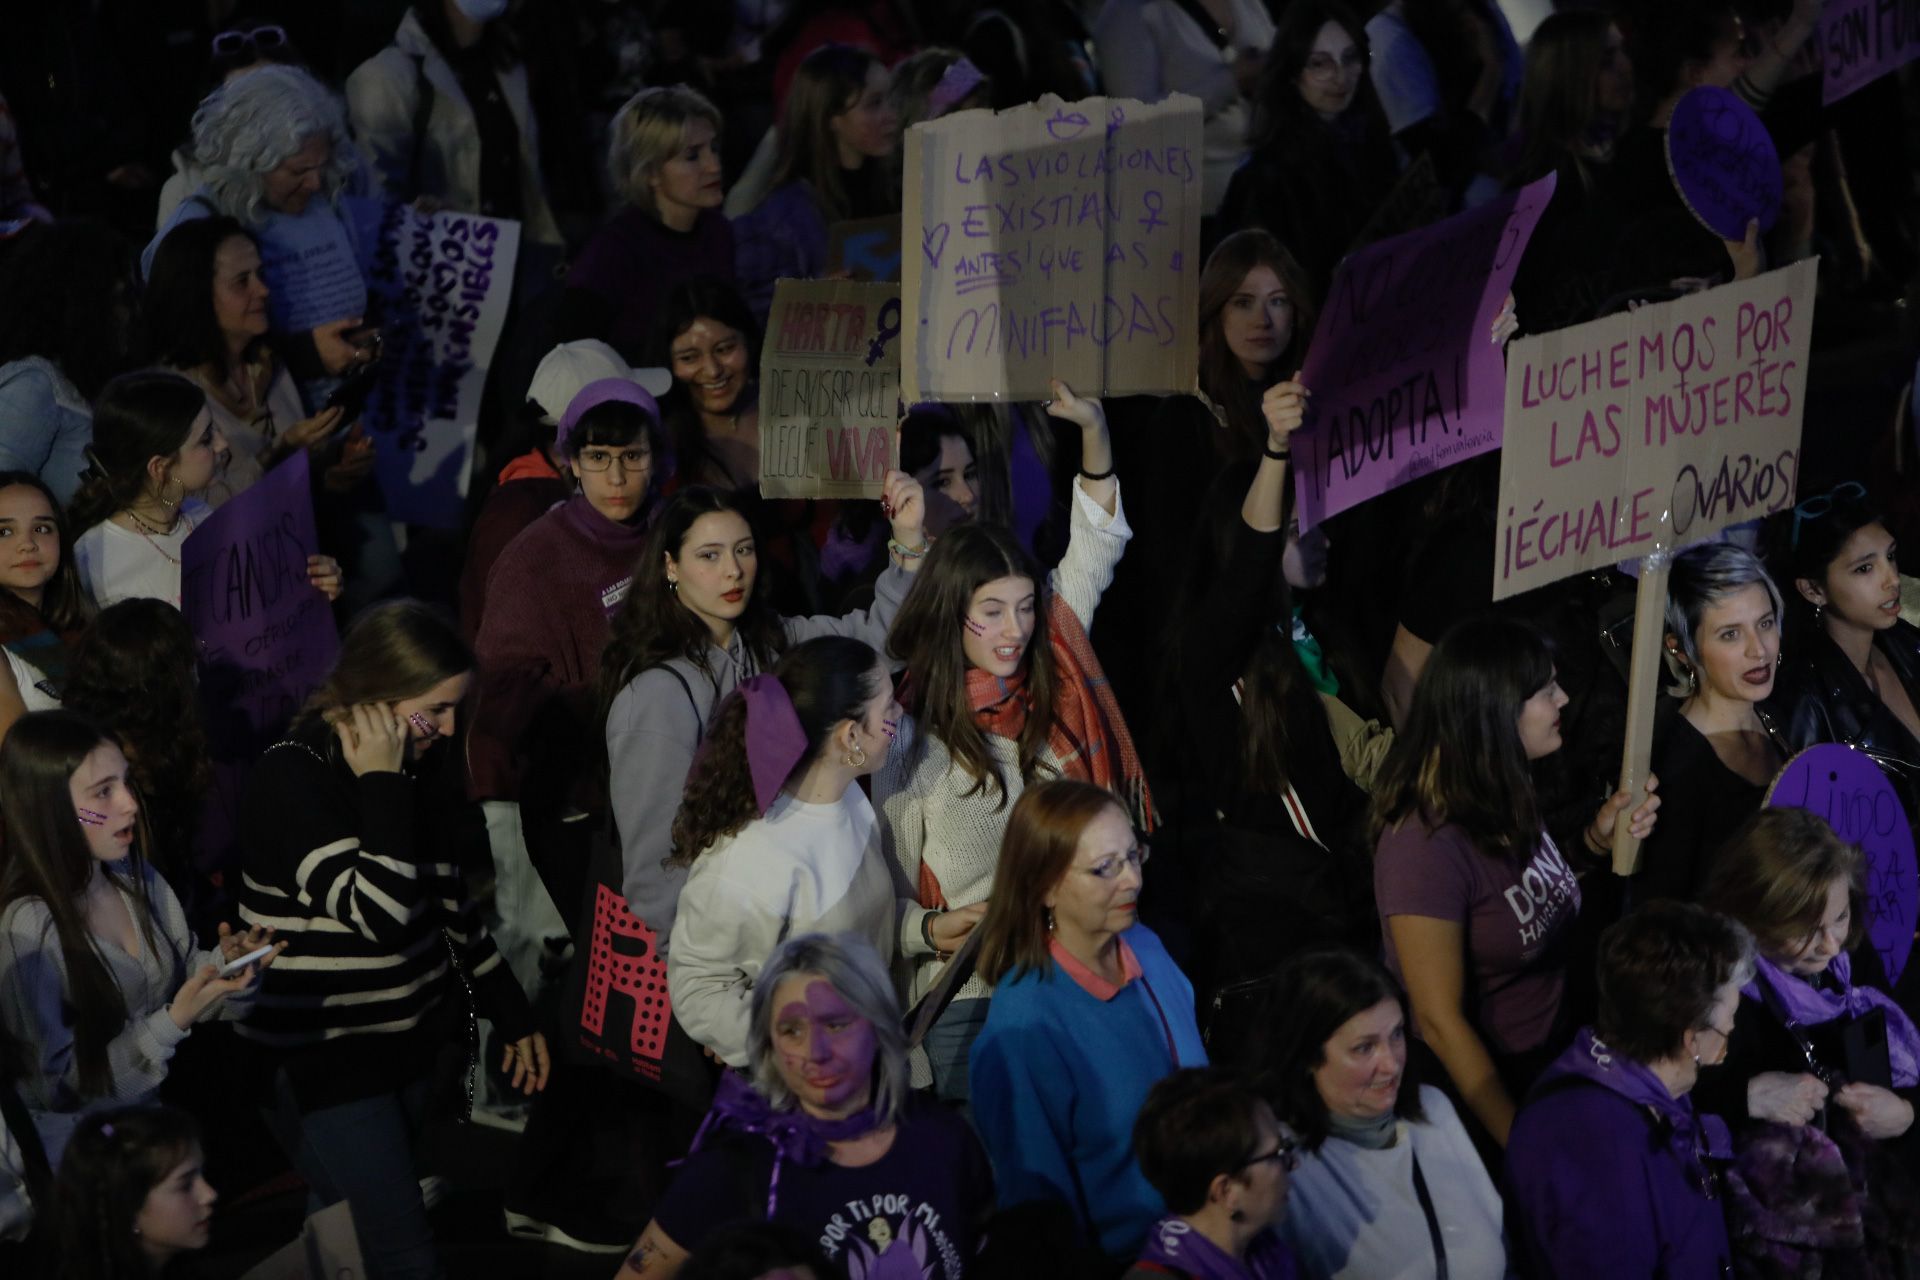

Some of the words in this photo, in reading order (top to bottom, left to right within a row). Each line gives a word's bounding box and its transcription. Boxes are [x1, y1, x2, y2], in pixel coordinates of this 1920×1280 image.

[1828, 5, 1869, 78] SON
[956, 153, 1020, 186] LAS
[1027, 146, 1194, 182] VIOLACIONES
[1039, 244, 1083, 280] QUE
[777, 302, 866, 352] HARTA
[947, 292, 1175, 360] MINIFALDAS
[1521, 316, 1716, 409] LUCHEMOS
[1736, 296, 1793, 370] POR
[770, 369, 793, 417] DE
[794, 369, 854, 418] AVISAR
[858, 370, 891, 418] QUE
[1549, 404, 1622, 468] LAS
[1645, 361, 1796, 446] MUJERES
[826, 427, 890, 481] VIVA
[1313, 354, 1463, 501] ¡ADOPTA!
[210, 511, 309, 625] CANSAS
[819, 1212, 853, 1254] POR
[871, 1193, 911, 1217] POR
